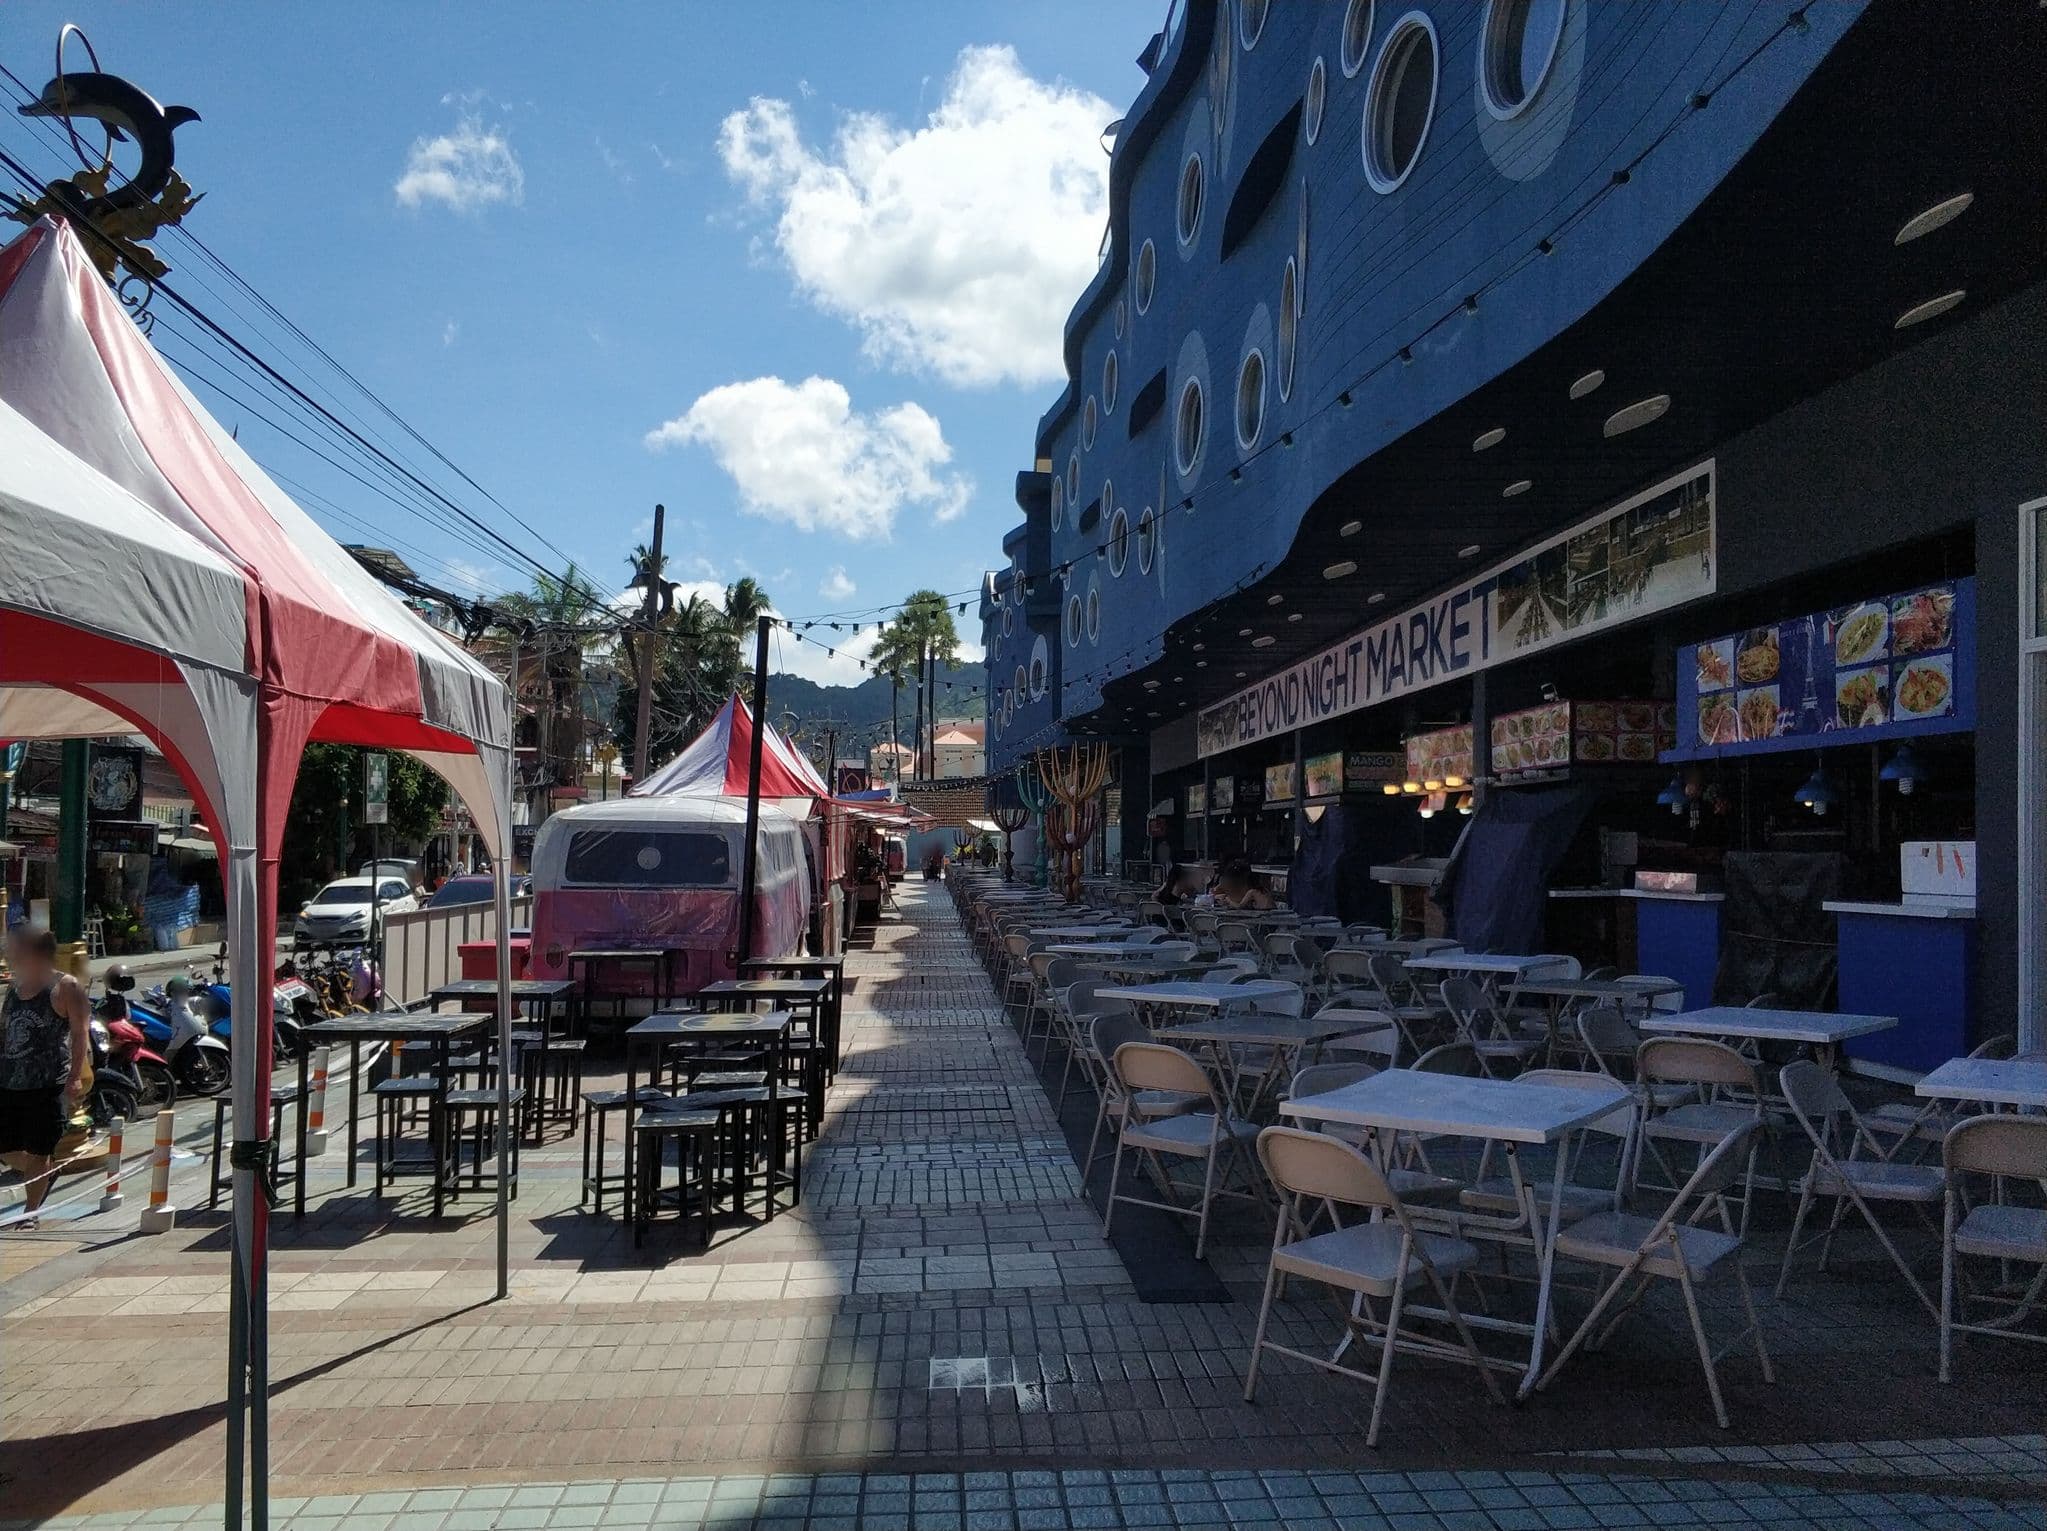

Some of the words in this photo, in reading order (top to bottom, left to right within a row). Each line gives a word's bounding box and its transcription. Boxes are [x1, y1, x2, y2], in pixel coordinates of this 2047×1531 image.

[1238, 672, 1299, 742] BEYOND
[1303, 642, 1363, 721] NIGHT
[1366, 576, 1498, 701] MARKET
[1350, 755, 1394, 767] MANGO
